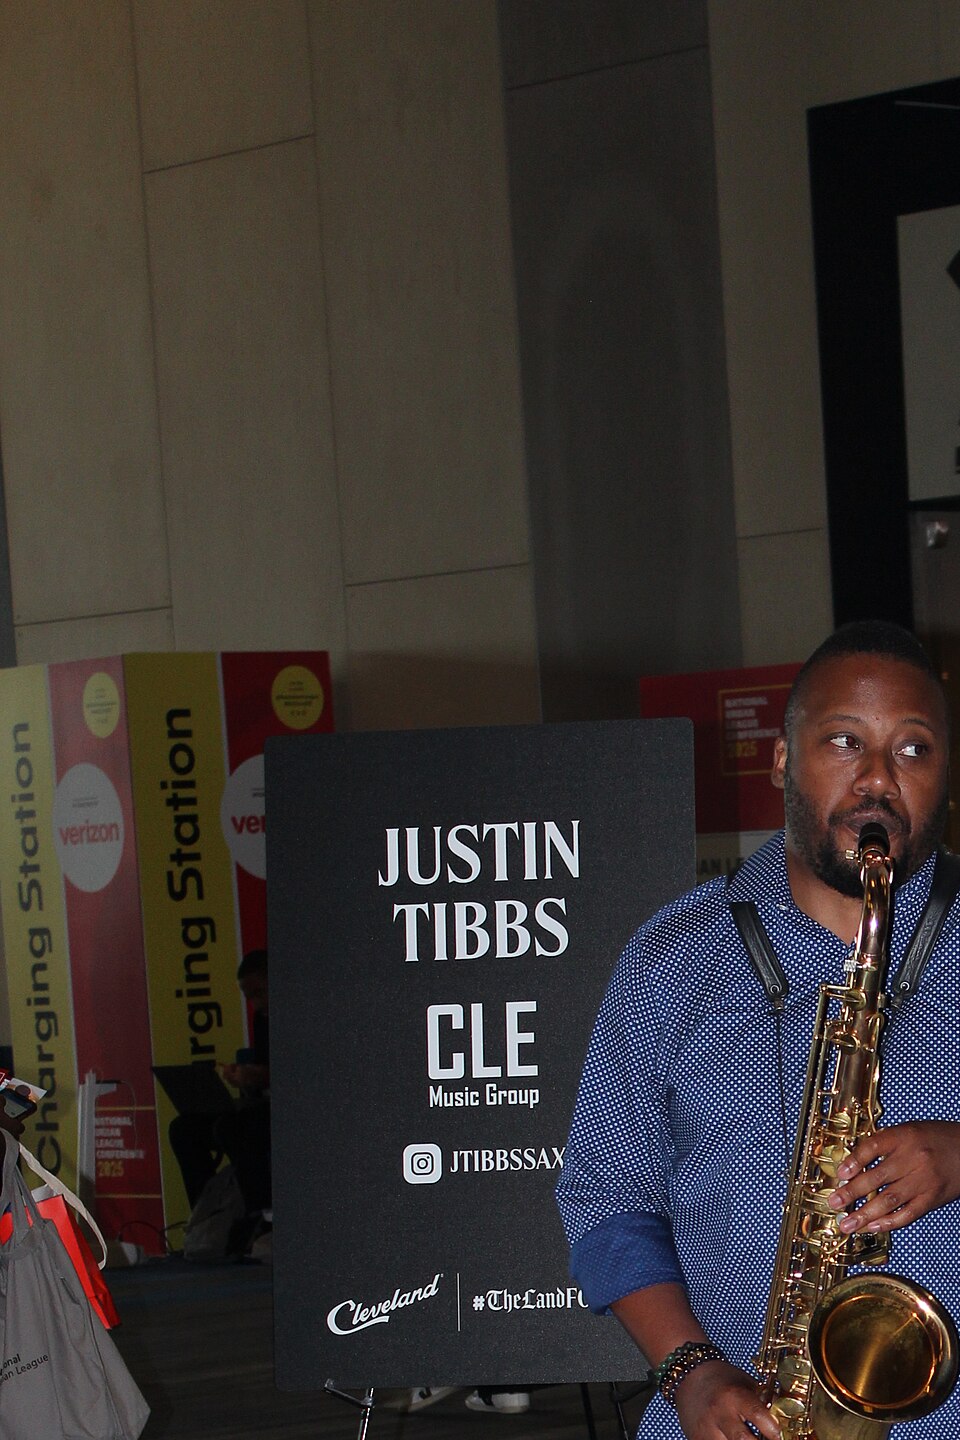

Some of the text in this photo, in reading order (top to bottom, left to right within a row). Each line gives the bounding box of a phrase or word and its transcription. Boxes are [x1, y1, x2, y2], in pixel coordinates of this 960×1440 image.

[11, 722, 43, 912] Station
[59, 819, 120, 846] verizon
[378, 819, 580, 887] JUSTIN
[160, 708, 223, 1067] rging Station
[393, 897, 569, 962] TIBBS
[426, 1000, 539, 1080] CLE
[429, 1083, 540, 1109] Music Group
[450, 1146, 566, 1173] JTIBBSSAX
[326, 1272, 442, 1336] Cleveland
[15, 1354, 49, 1375] League
